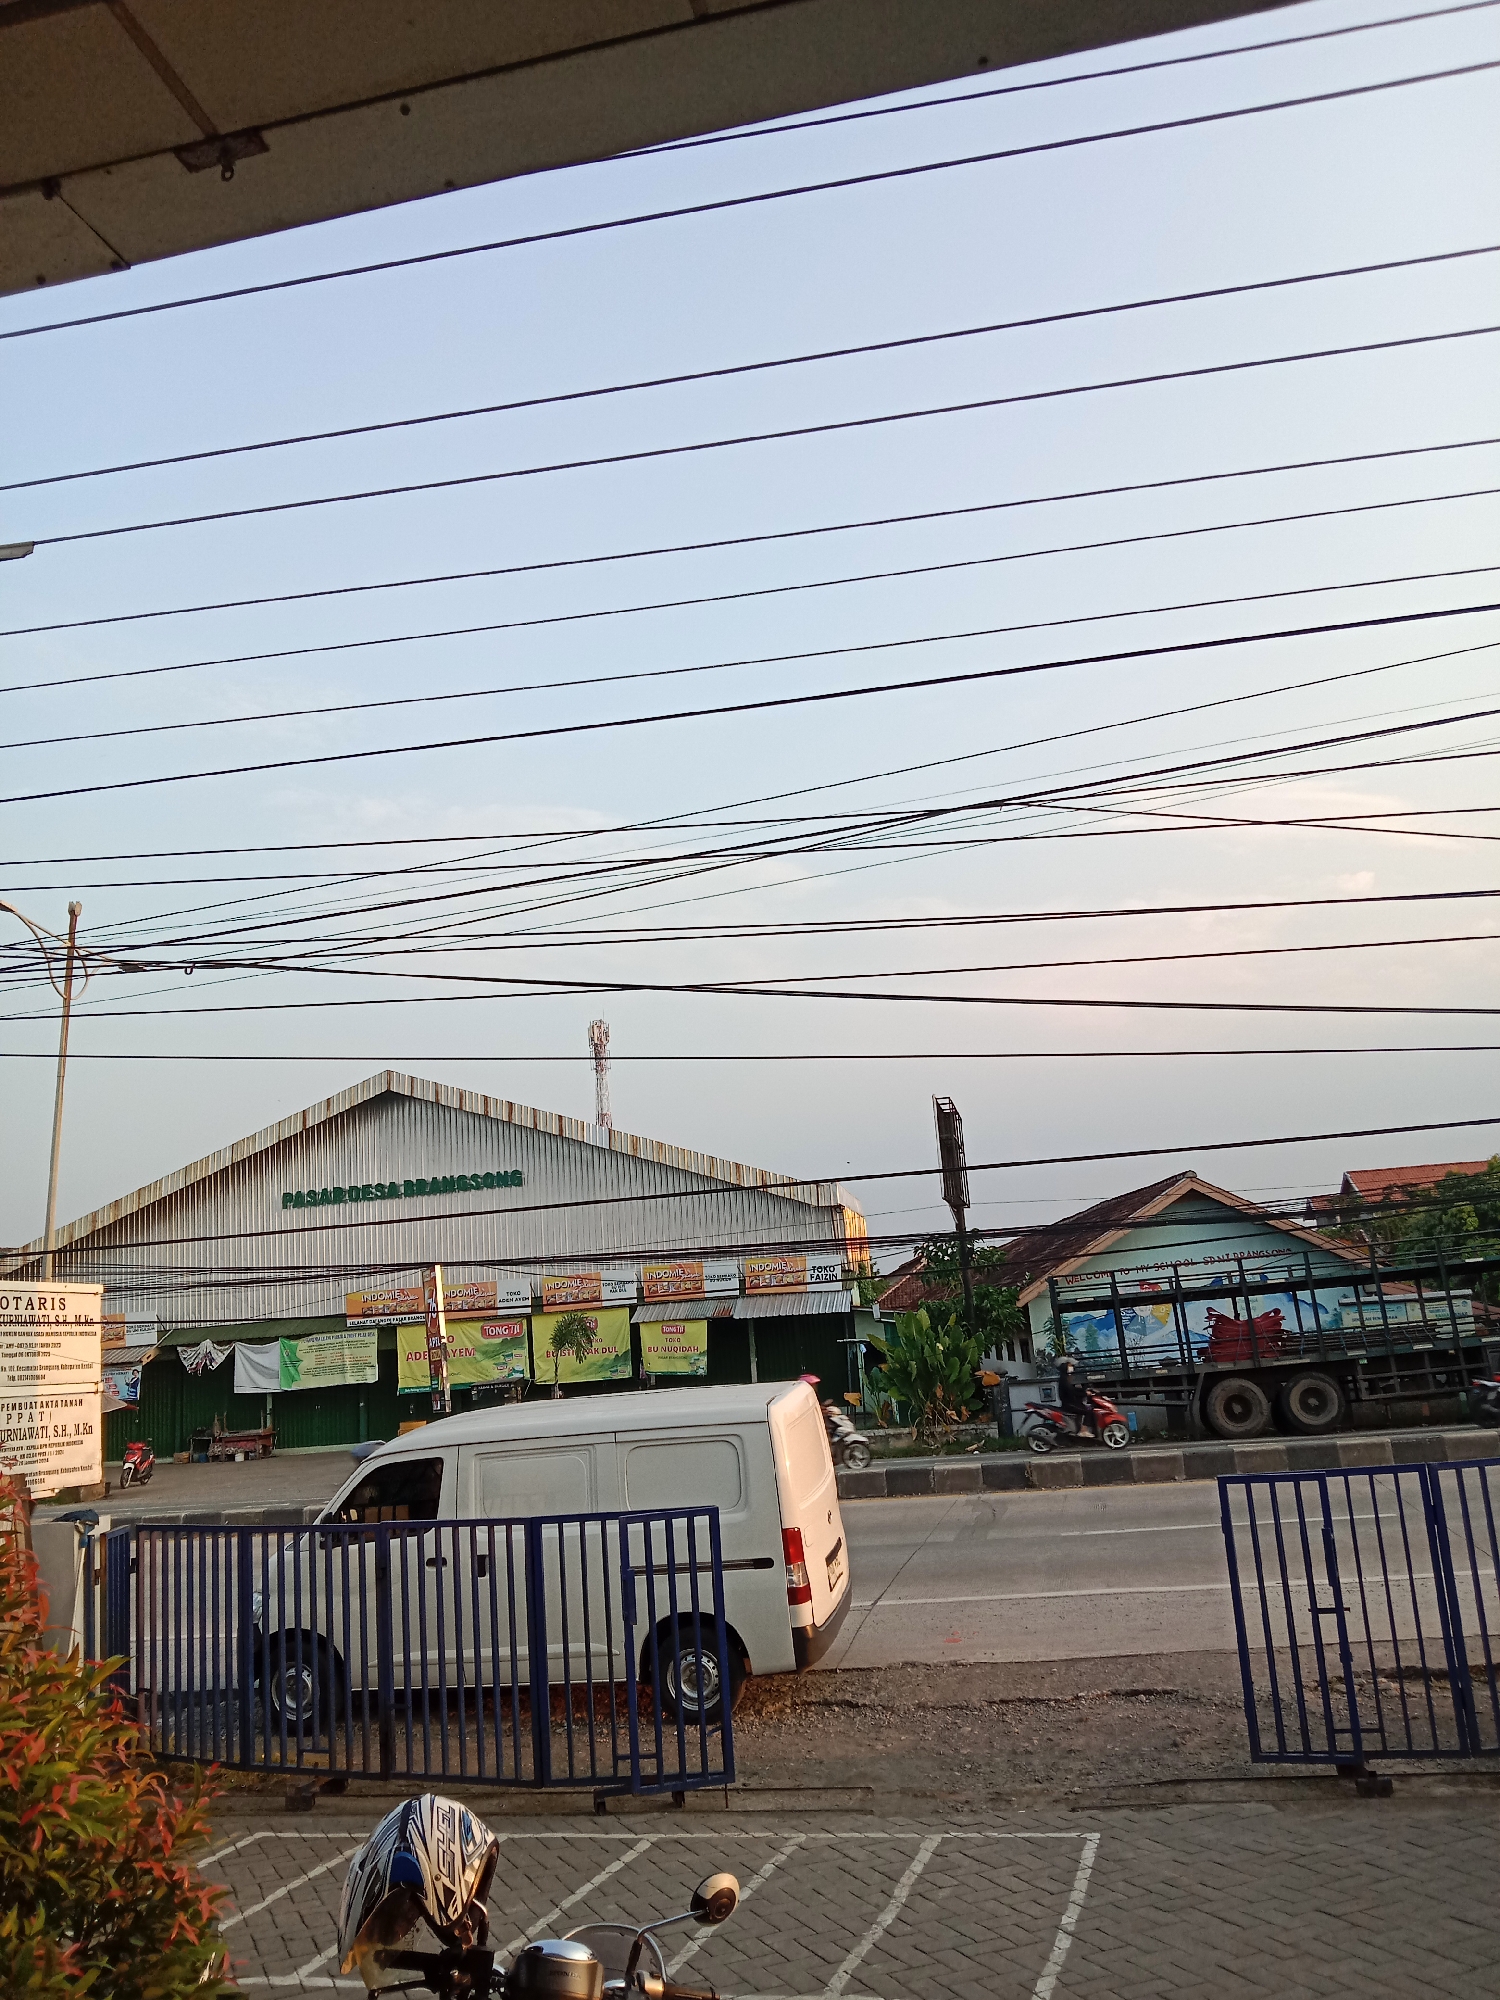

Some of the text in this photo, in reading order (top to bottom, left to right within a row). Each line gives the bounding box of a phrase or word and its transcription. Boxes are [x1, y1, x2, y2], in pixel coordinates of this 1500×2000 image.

[282, 1169, 523, 1209] PASAR DESA BRANGSONG
[748, 1262, 787, 1273] INDOMIE
[811, 1265, 835, 1273] TOKO
[646, 1269, 684, 1280] INDOMIE
[810, 1273, 838, 1281] FAIZIN
[1065, 1271, 1113, 1285] WELCOM
[1136, 1264, 1149, 1274] MY
[545, 1278, 582, 1291] INDOMIE
[362, 1289, 400, 1303] INDOMIE
[444, 1286, 478, 1299] NDOMIE
[0, 1295, 66, 1310] OTARIS
[484, 1324, 520, 1336] TONG TJI
[663, 1325, 676, 1333] TONG
[602, 1346, 618, 1354] DUL
[661, 1346, 699, 1354] NUQIDAH
[1, 1399, 83, 1412] PEMBUAT AKTA TANAH
[53, 1425, 72, 1439] S.H.,
[74, 1423, 93, 1436] M.Kn
